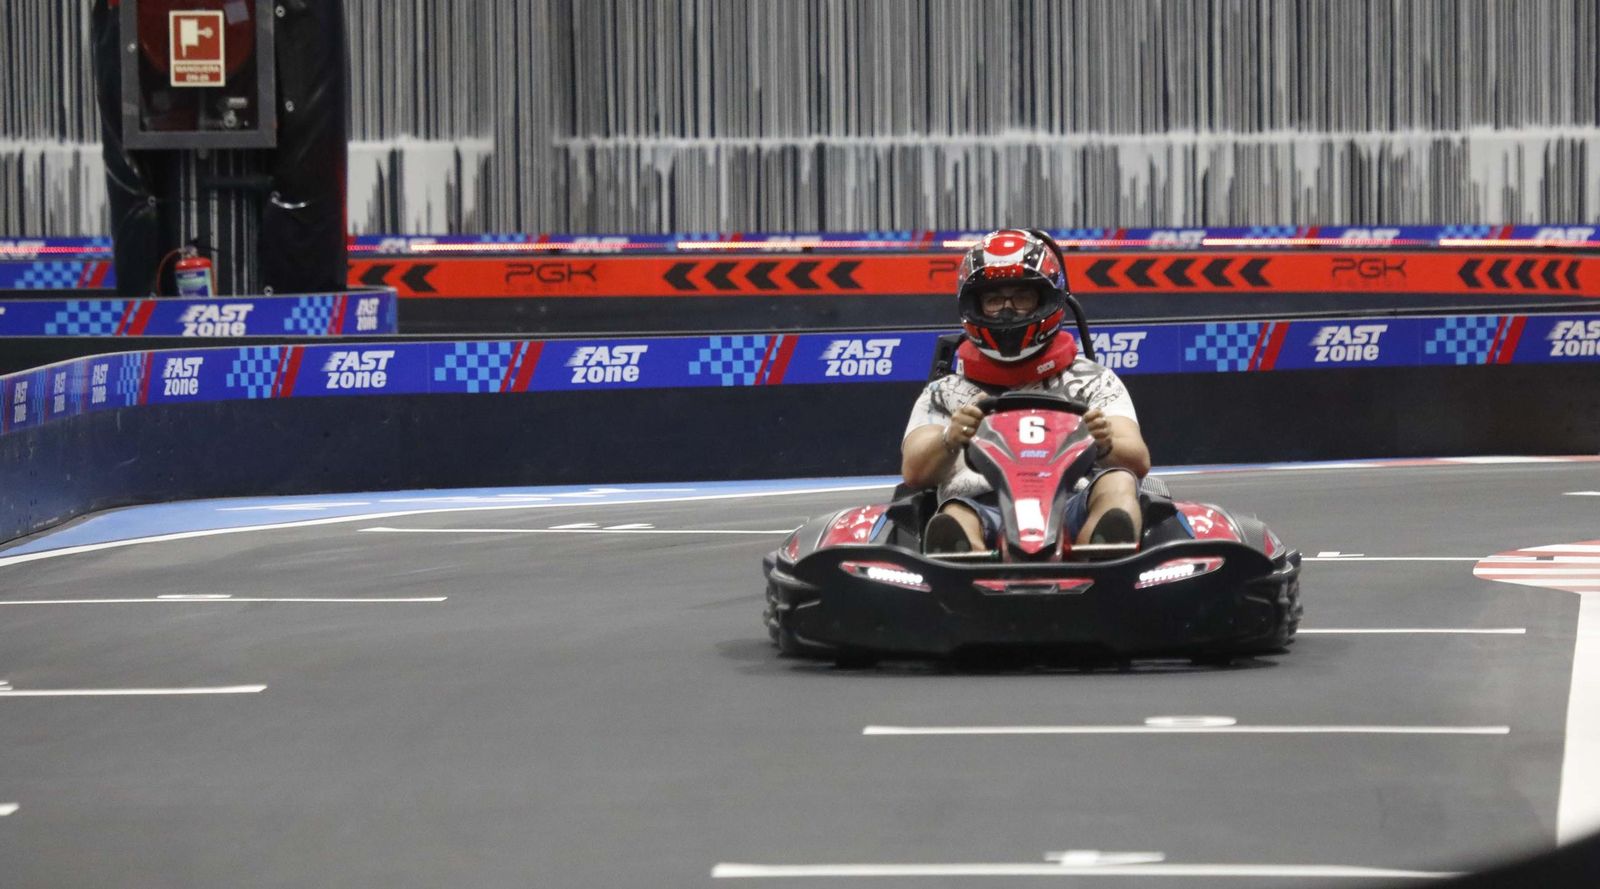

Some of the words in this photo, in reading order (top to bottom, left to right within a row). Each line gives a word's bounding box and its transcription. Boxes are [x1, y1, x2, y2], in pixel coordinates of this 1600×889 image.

[505, 262, 597, 283] PGK
[1332, 257, 1407, 279] PGK
[179, 304, 253, 322] FAST
[182, 322, 246, 337] zone
[1310, 325, 1388, 344] FAST
[1547, 321, 1600, 339] FAS
[566, 345, 648, 365] FAST
[821, 339, 901, 359] FAST
[1315, 344, 1379, 361] zone
[1550, 339, 1600, 356] zon
[163, 357, 204, 377] FAST
[322, 351, 394, 371] FAST
[825, 358, 893, 376] zone
[1095, 351, 1139, 369] one
[92, 363, 109, 385] FAST
[326, 370, 387, 388] zone
[571, 365, 640, 383] zone
[164, 377, 199, 396] zone
[1018, 416, 1045, 444] 6
